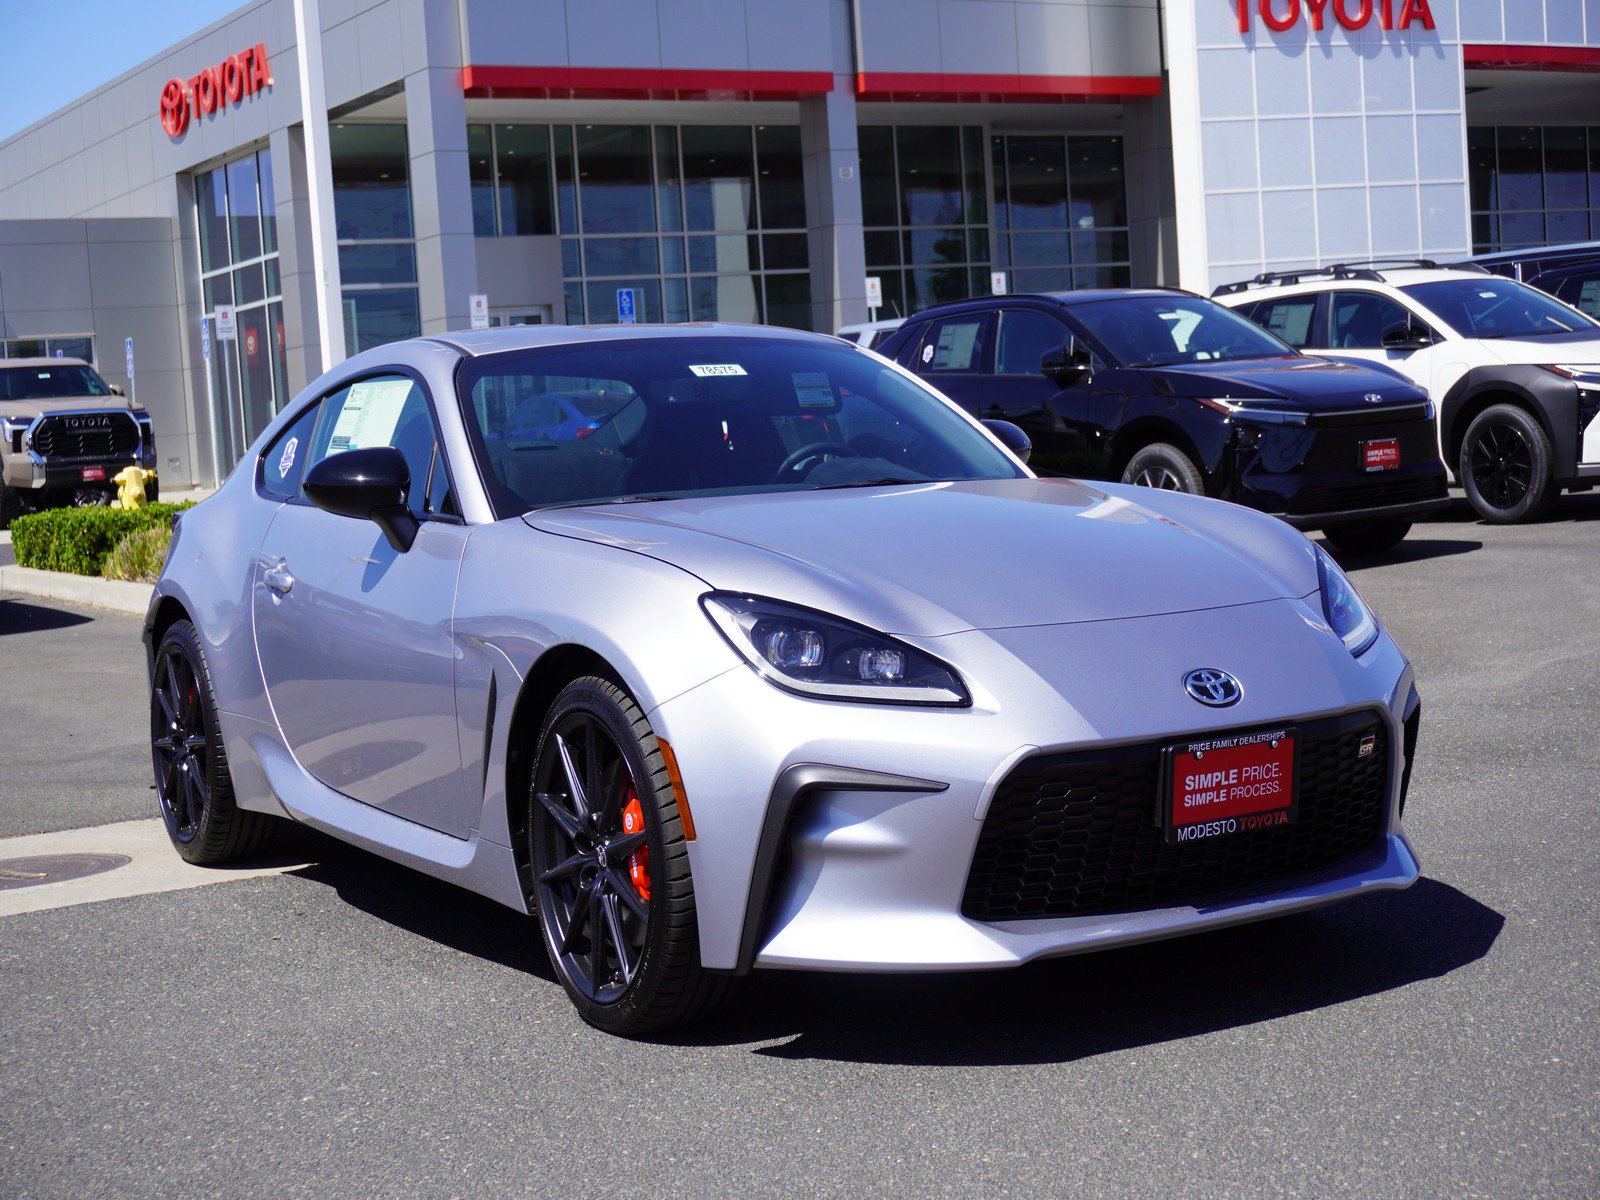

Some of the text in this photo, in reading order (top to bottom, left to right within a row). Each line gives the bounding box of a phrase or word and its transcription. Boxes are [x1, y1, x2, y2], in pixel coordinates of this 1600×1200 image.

[187, 42, 271, 120] TOYOTA
[697, 366, 738, 375] 78575
[64, 417, 111, 429] TOYOTA
[1188, 731, 1286, 753] PRICE FAMILY DEALERSHIPS
[1185, 762, 1282, 791] SIMPLE PRICE.
[1184, 781, 1282, 808] SIMPLE PROCESS.
[1177, 811, 1289, 842] MODESTO TOYOTA
